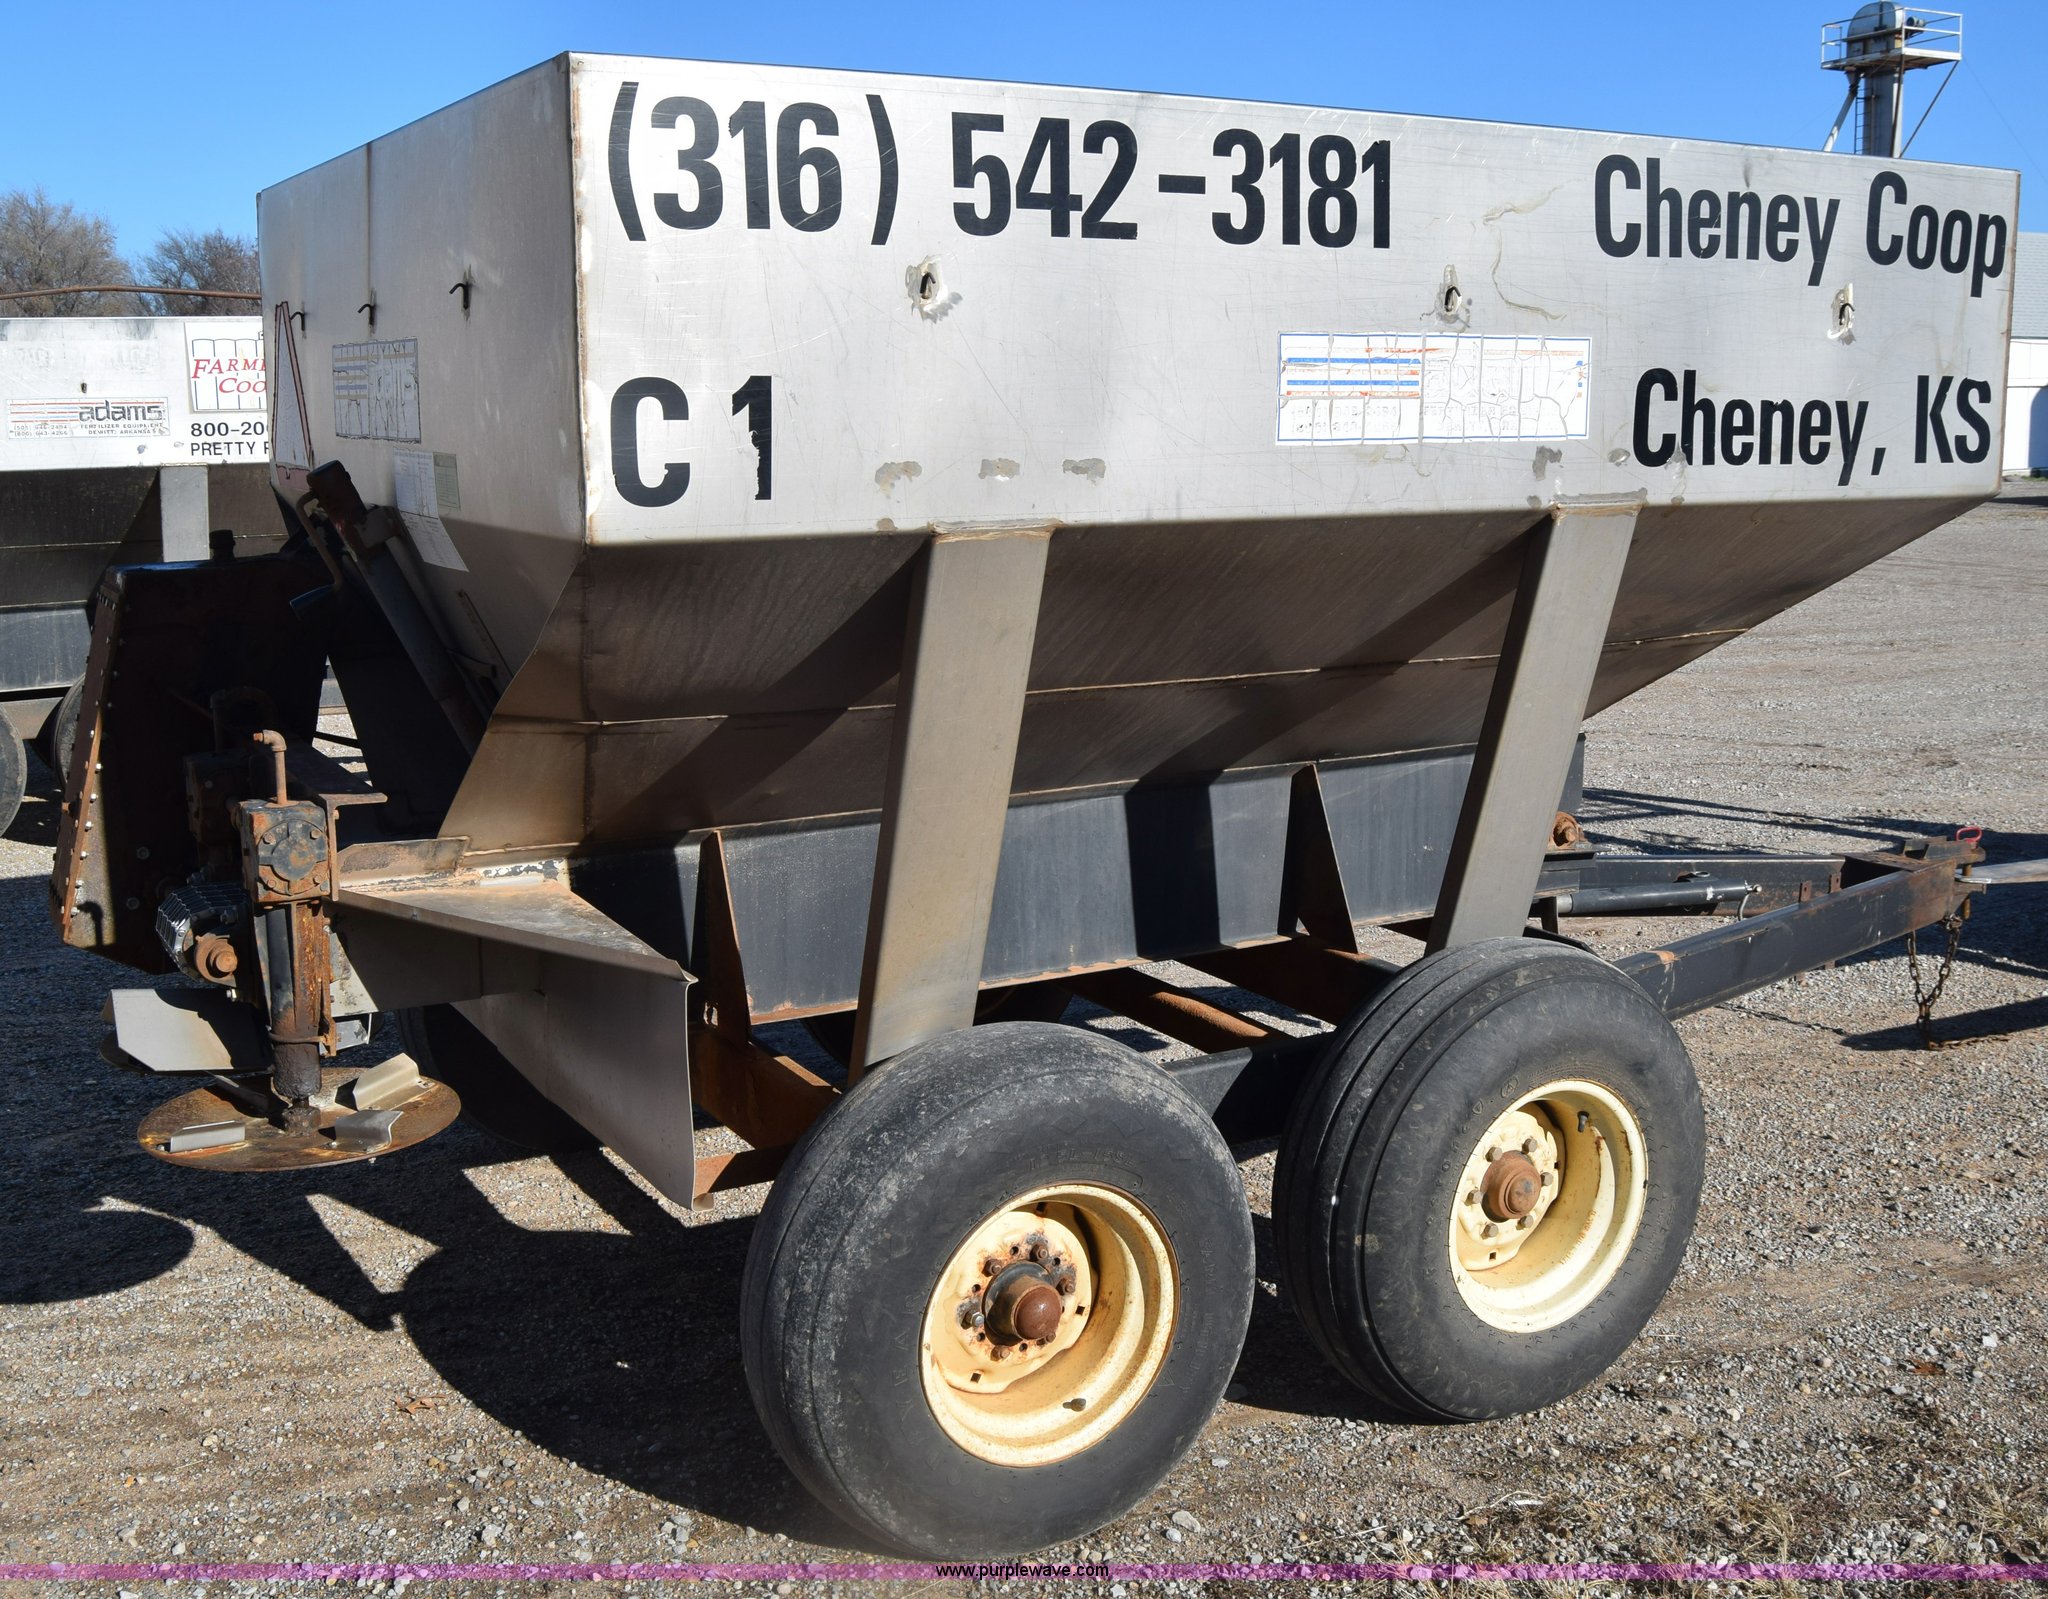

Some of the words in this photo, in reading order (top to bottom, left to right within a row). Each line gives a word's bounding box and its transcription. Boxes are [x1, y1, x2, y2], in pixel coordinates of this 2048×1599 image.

[608, 81, 899, 245] (316)
[1594, 154, 1841, 287] Cheney
[1866, 170, 2007, 298] Coop
[79, 400, 163, 421] adams
[190, 441, 256, 456] PRETTY
[191, 421, 268, 437] 800-20
[610, 376, 690, 508] C
[732, 375, 772, 501] 1
[1632, 368, 1887, 487] Cheney,
[1914, 375, 1992, 464] KS
